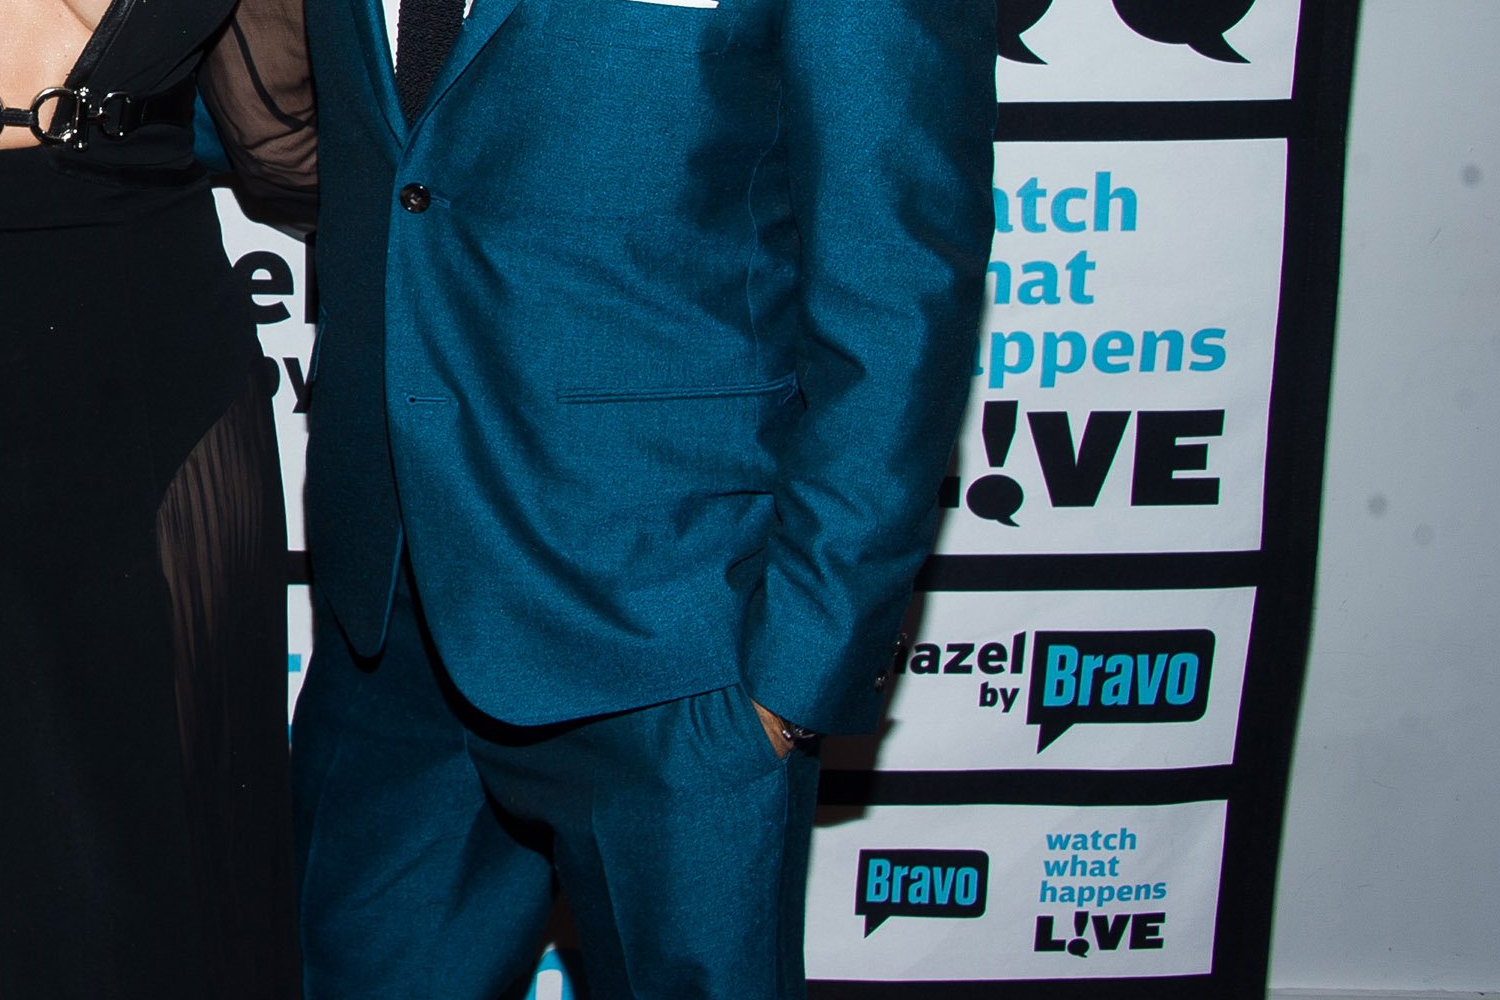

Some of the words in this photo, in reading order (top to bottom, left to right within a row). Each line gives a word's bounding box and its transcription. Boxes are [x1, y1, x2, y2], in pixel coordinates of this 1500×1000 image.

[972, 327, 1226, 389] ppens
[1042, 644, 1199, 707] Bravo
[979, 681, 1020, 713] by
[1045, 827, 1138, 852] watch
[866, 858, 979, 906] Bravo
[1043, 853, 1121, 879] what
[1039, 878, 1168, 909] happens
